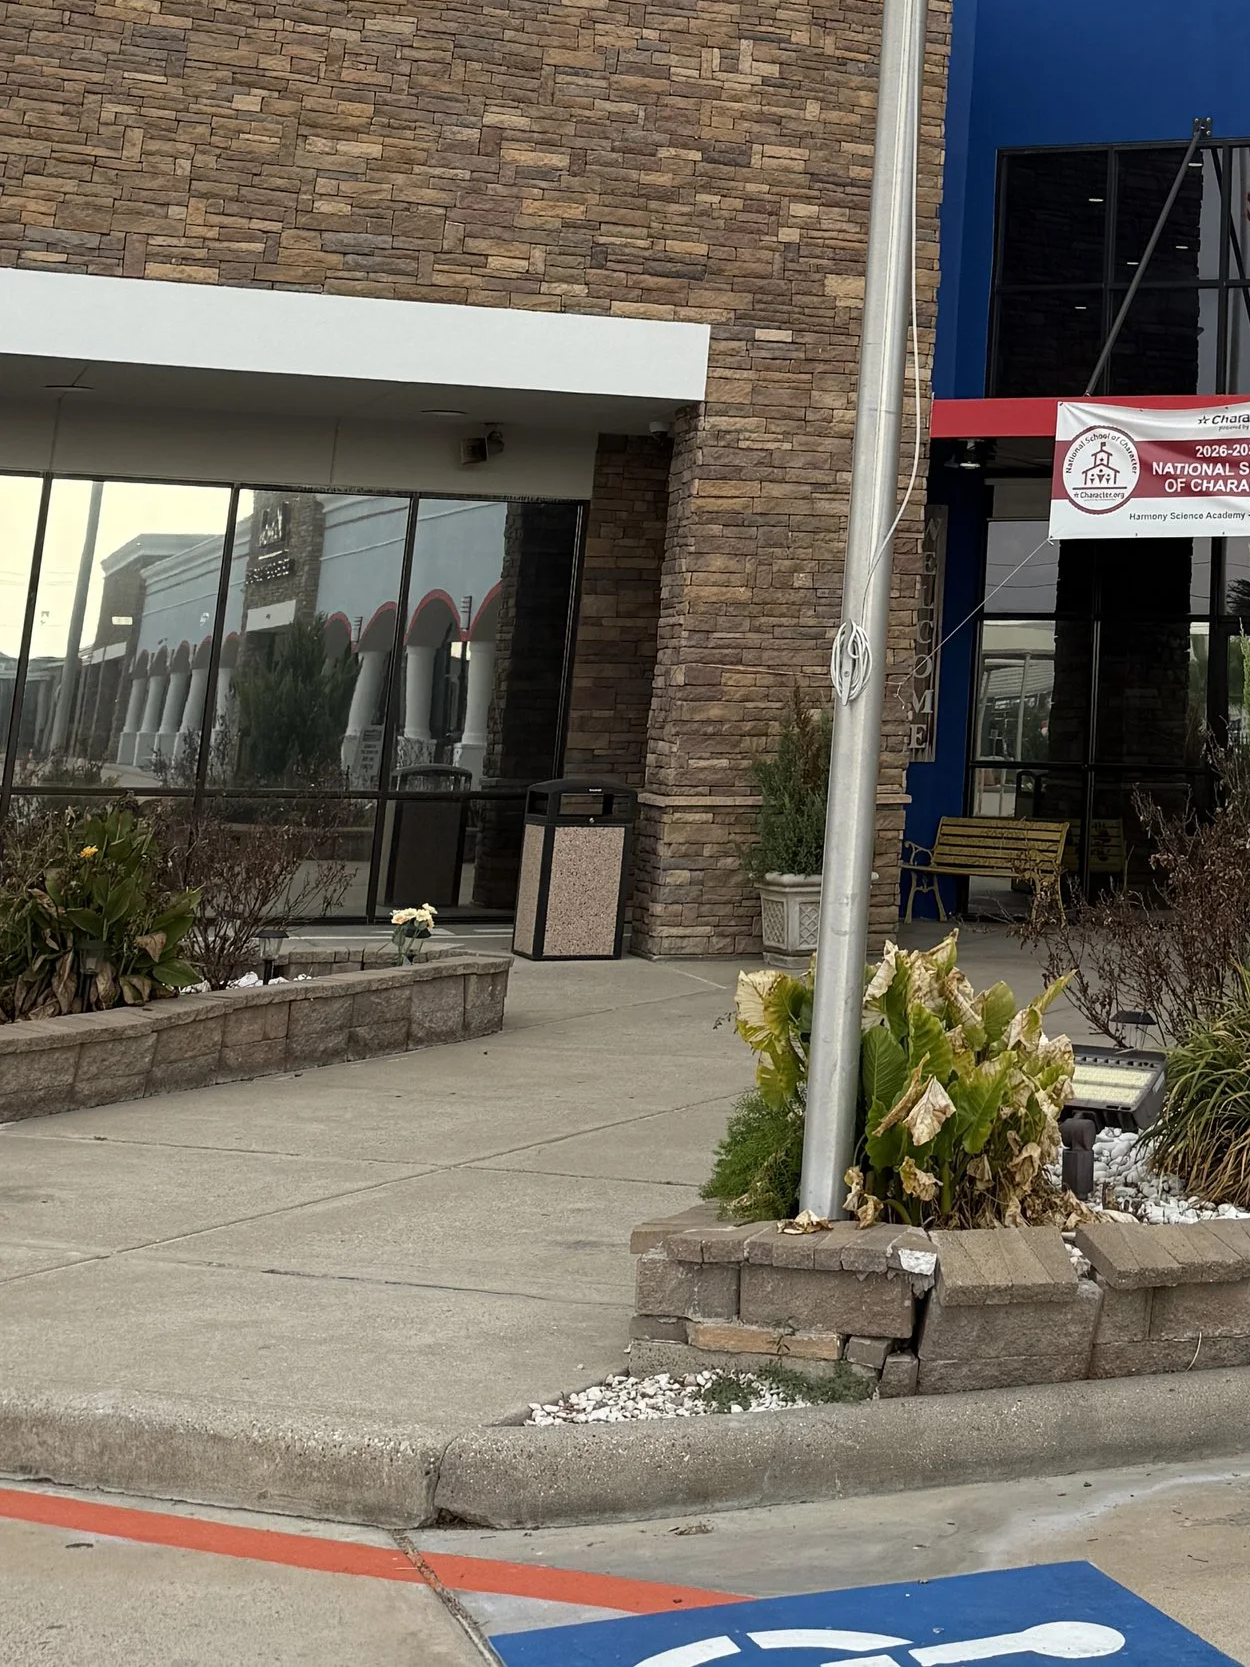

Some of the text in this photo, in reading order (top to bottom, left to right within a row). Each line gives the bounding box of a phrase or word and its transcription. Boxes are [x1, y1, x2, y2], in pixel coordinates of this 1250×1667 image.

[1066, 441, 1086, 474] National
[1085, 433, 1111, 444] School
[1119, 439, 1138, 474] Character
[1152, 462, 1235, 476] NATIONAL
[1164, 478, 1187, 493] OF
[1129, 512, 1167, 523] Harmony
[1170, 511, 1203, 521] Science
[1206, 510, 1246, 522] Academy
[910, 517, 943, 749] WELCOME
